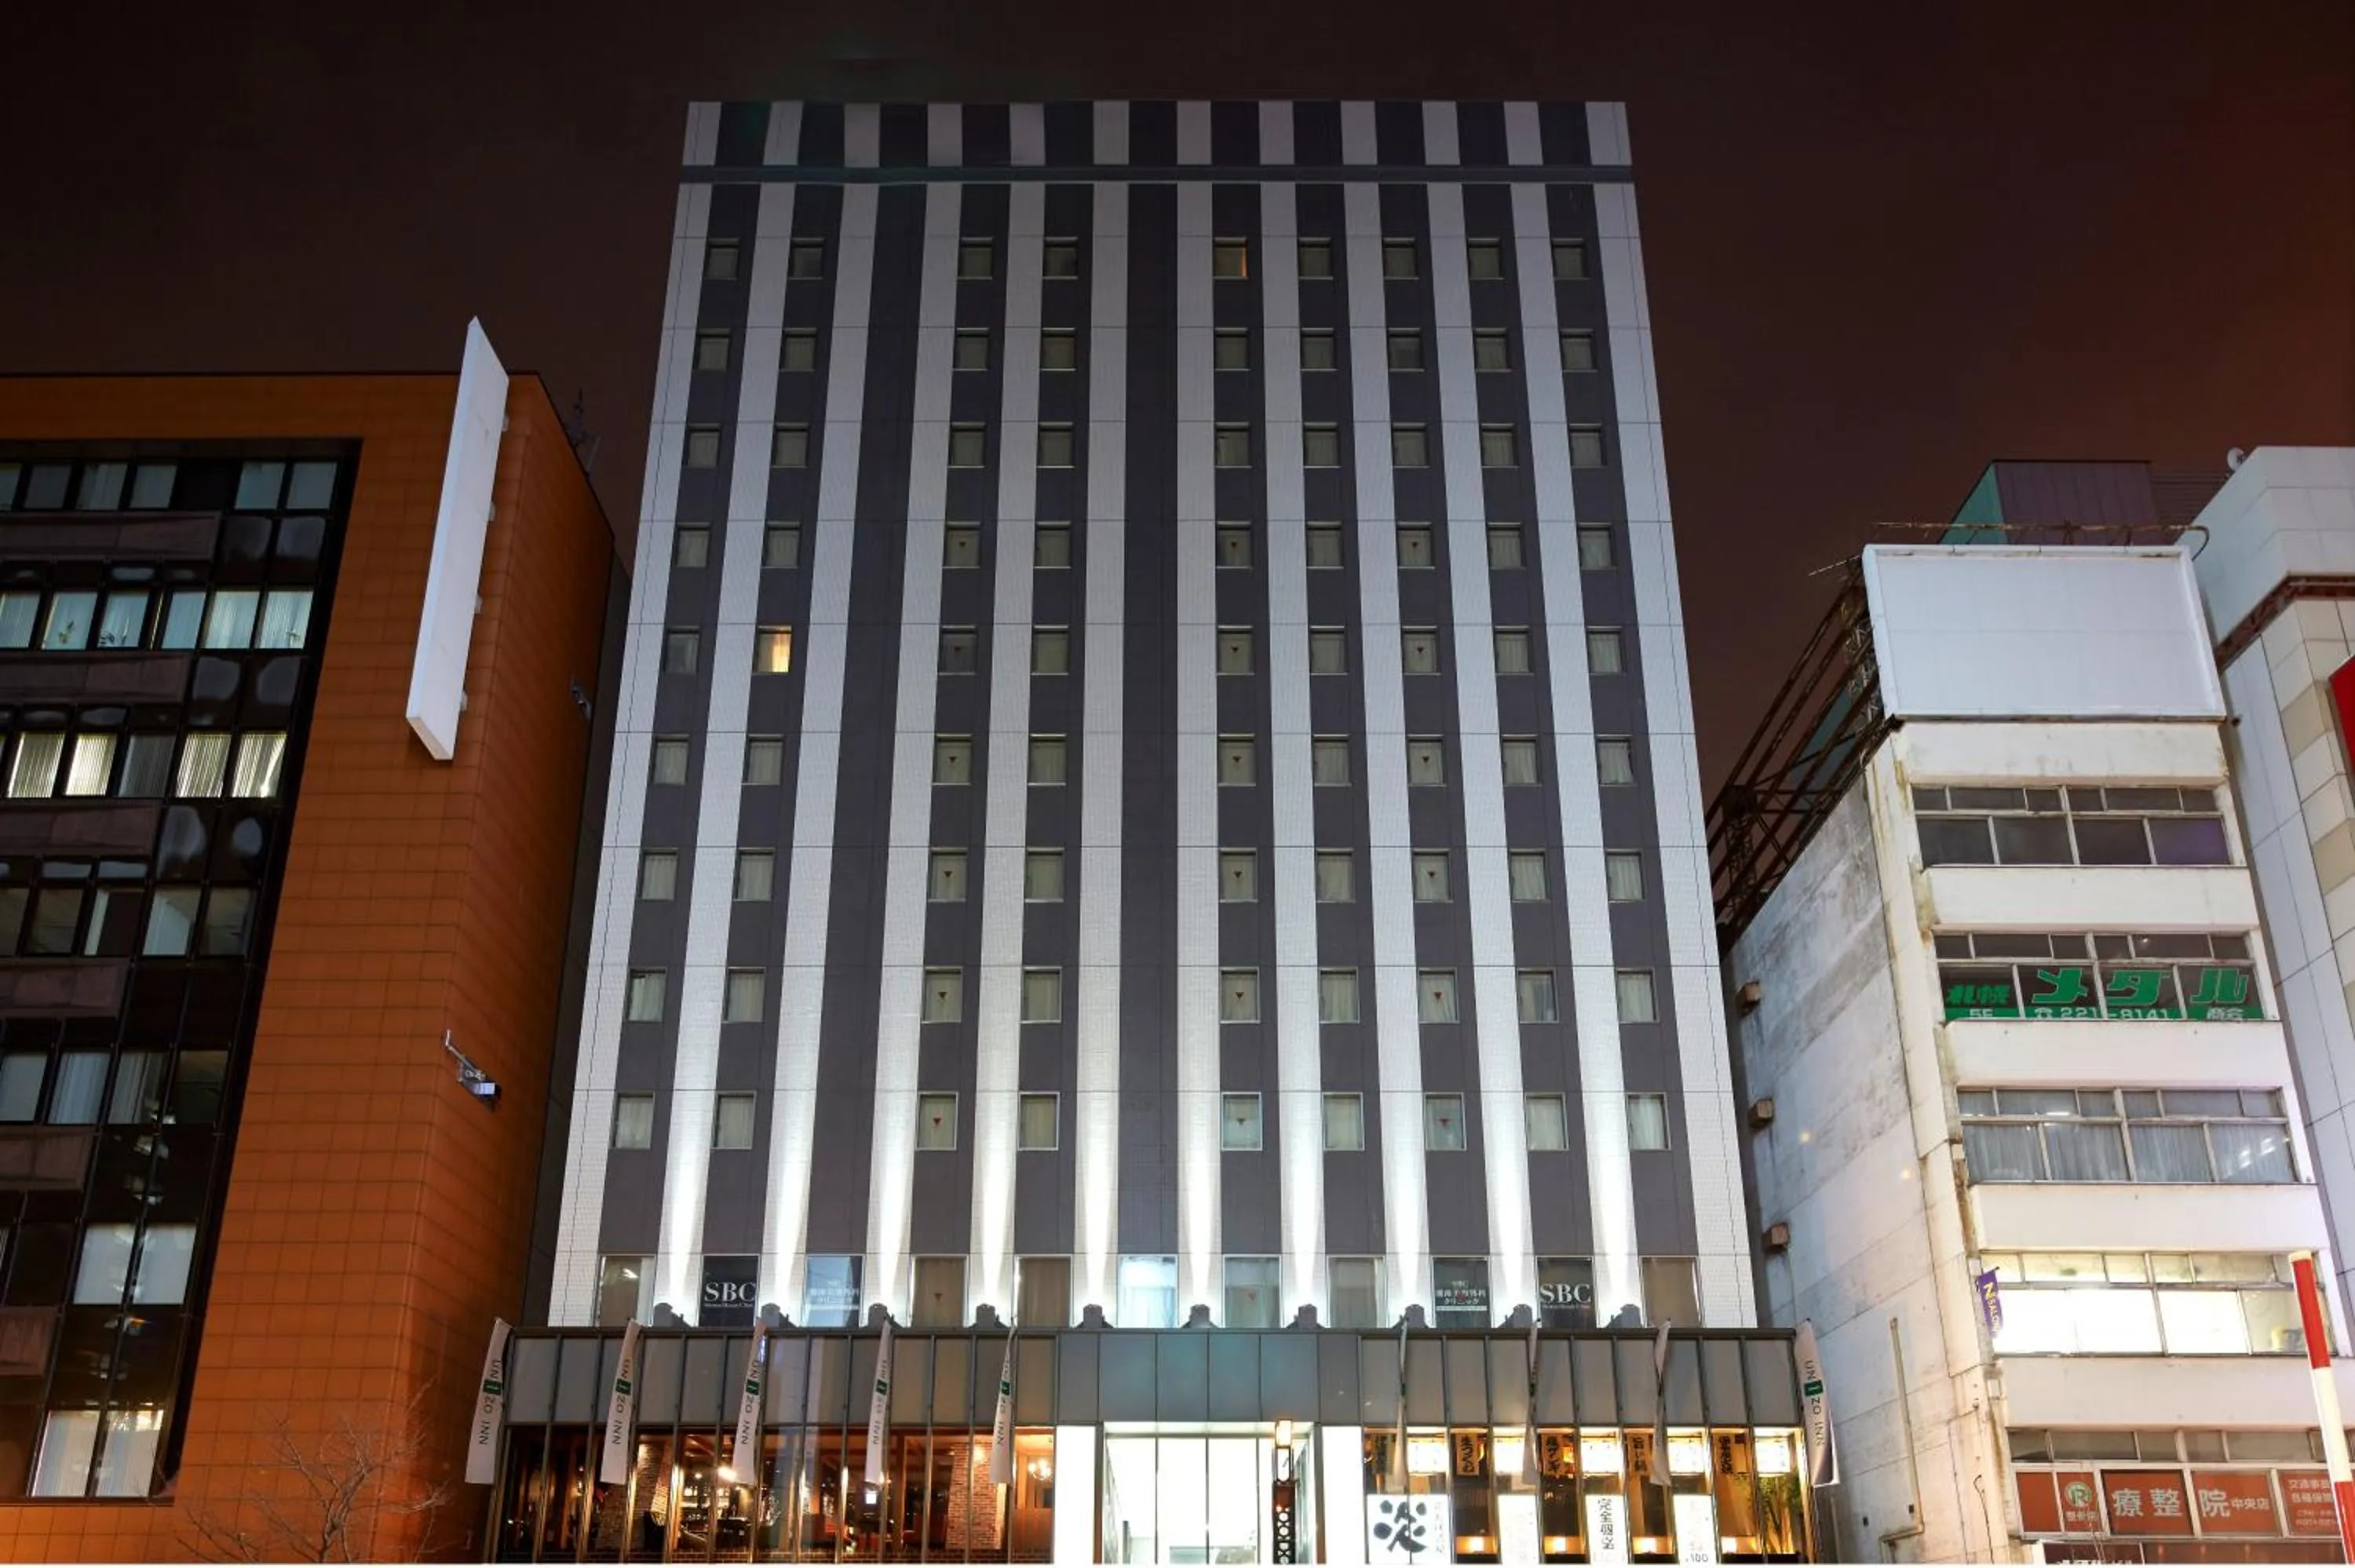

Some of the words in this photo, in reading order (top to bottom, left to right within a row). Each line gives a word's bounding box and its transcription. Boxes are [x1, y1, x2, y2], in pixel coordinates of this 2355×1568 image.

[704, 1282, 756, 1302] SBC
[1539, 1283, 1591, 1304] SBC
[483, 1358, 503, 1414] UNIZO
[615, 1358, 631, 1413] UNIZO
[744, 1358, 760, 1413] UNIZO
[1804, 1359, 1824, 1415] UNIZO
[477, 1419, 491, 1445] INN
[612, 1419, 623, 1445] INN
[740, 1419, 750, 1445] INN
[1813, 1420, 1827, 1446] INN
